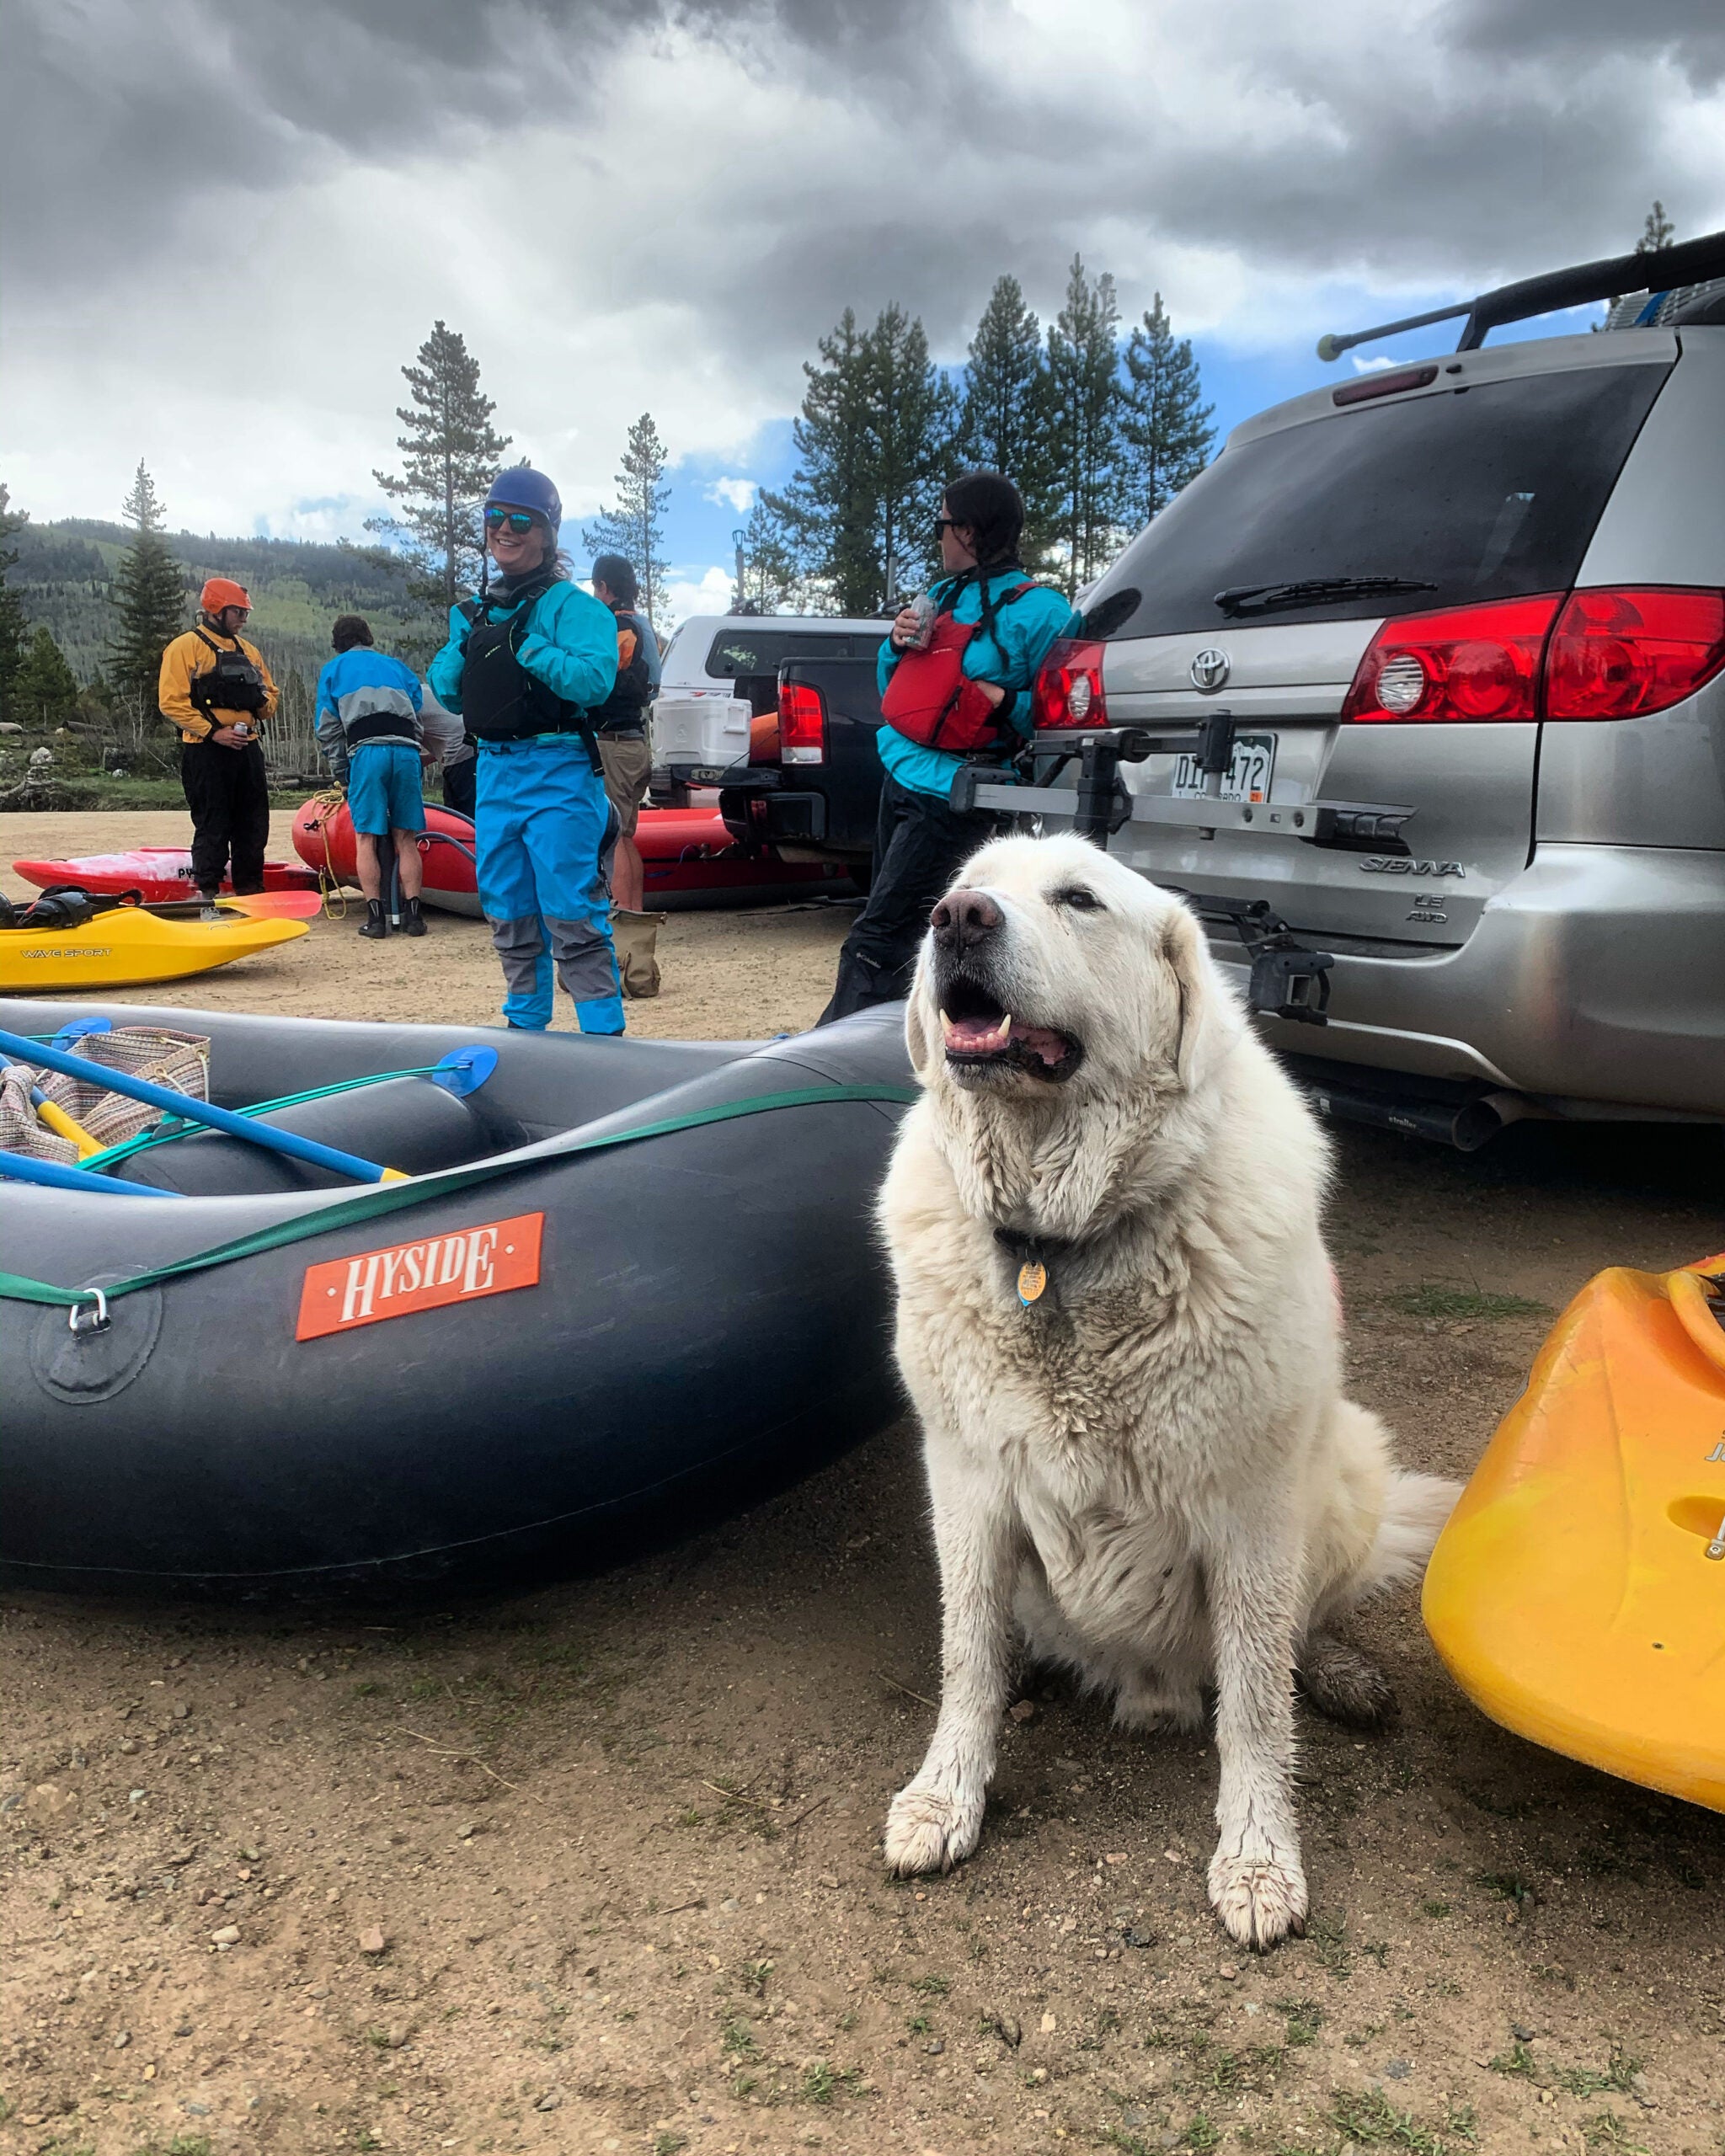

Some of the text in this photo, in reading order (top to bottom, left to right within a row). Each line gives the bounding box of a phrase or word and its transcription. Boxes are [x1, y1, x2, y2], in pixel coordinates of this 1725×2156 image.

[1359, 857, 1466, 878] SIENNA
[1414, 894, 1445, 908] LE
[1406, 910, 1448, 924] AWD
[21, 948, 113, 958] WAVE SPORT
[339, 1227, 498, 1323] HYSIDE
